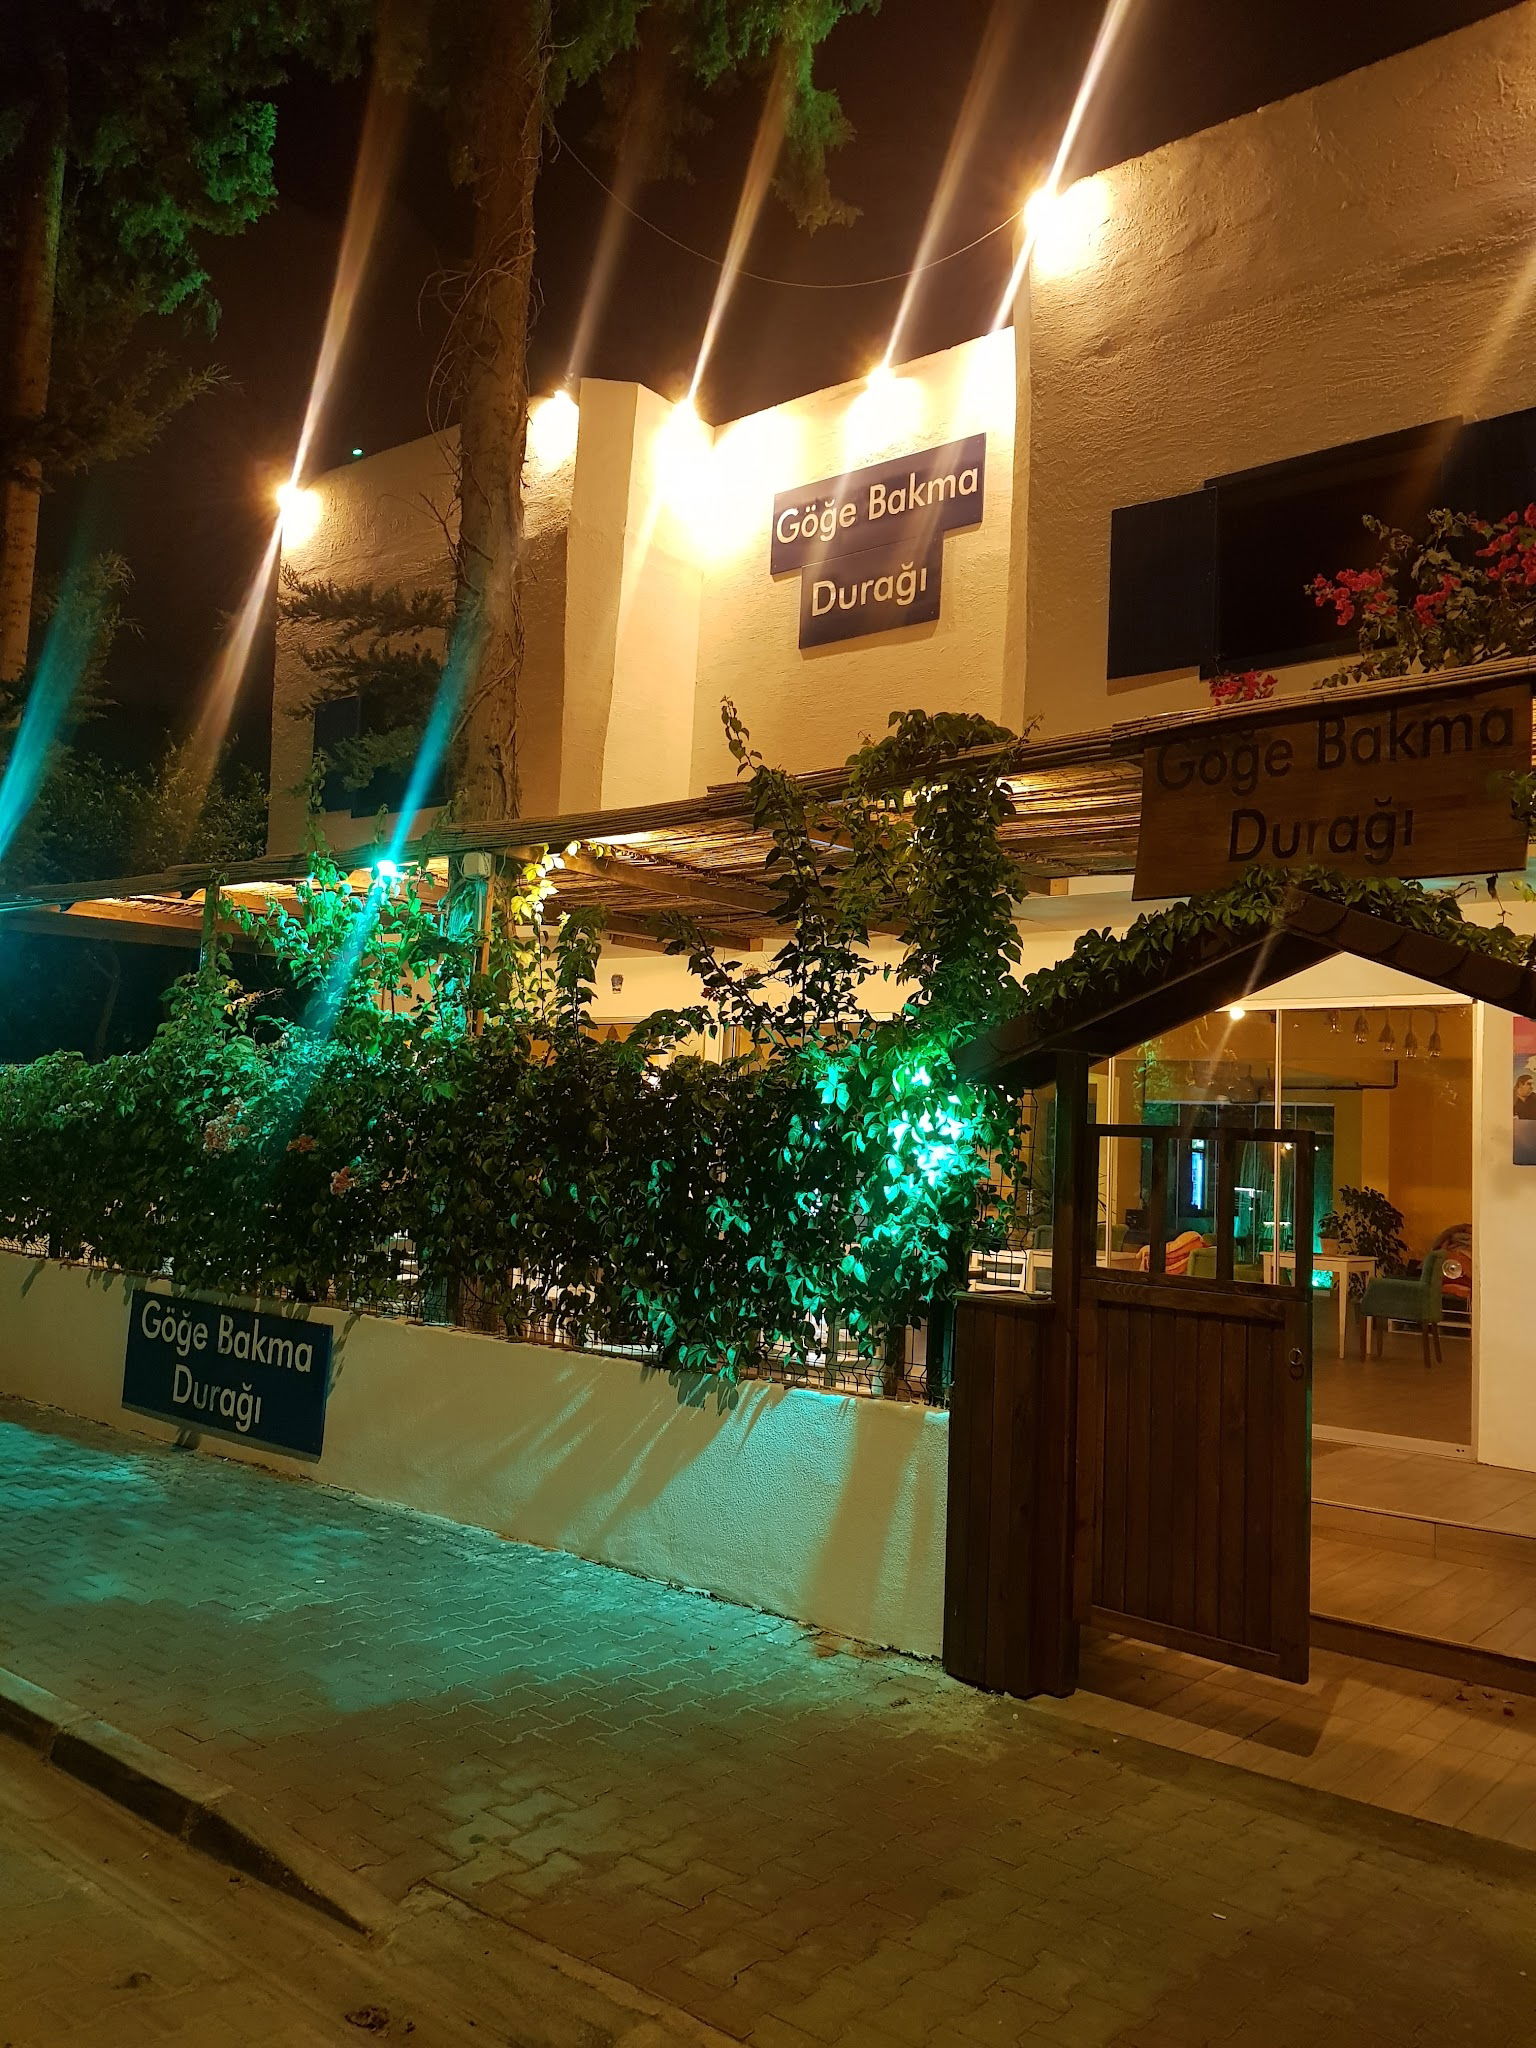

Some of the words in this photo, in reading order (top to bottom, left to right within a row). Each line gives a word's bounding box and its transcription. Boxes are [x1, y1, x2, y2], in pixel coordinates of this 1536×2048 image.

[776, 499, 857, 545] Göğe
[868, 467, 978, 521] Bakma
[811, 561, 927, 617] Durağı
[1316, 707, 1514, 771] Bakma
[1228, 796, 1415, 865] Durağı
[141, 1300, 209, 1357] Göğe
[217, 1314, 313, 1373] Bakma
[172, 1363, 262, 1432] Durağı
